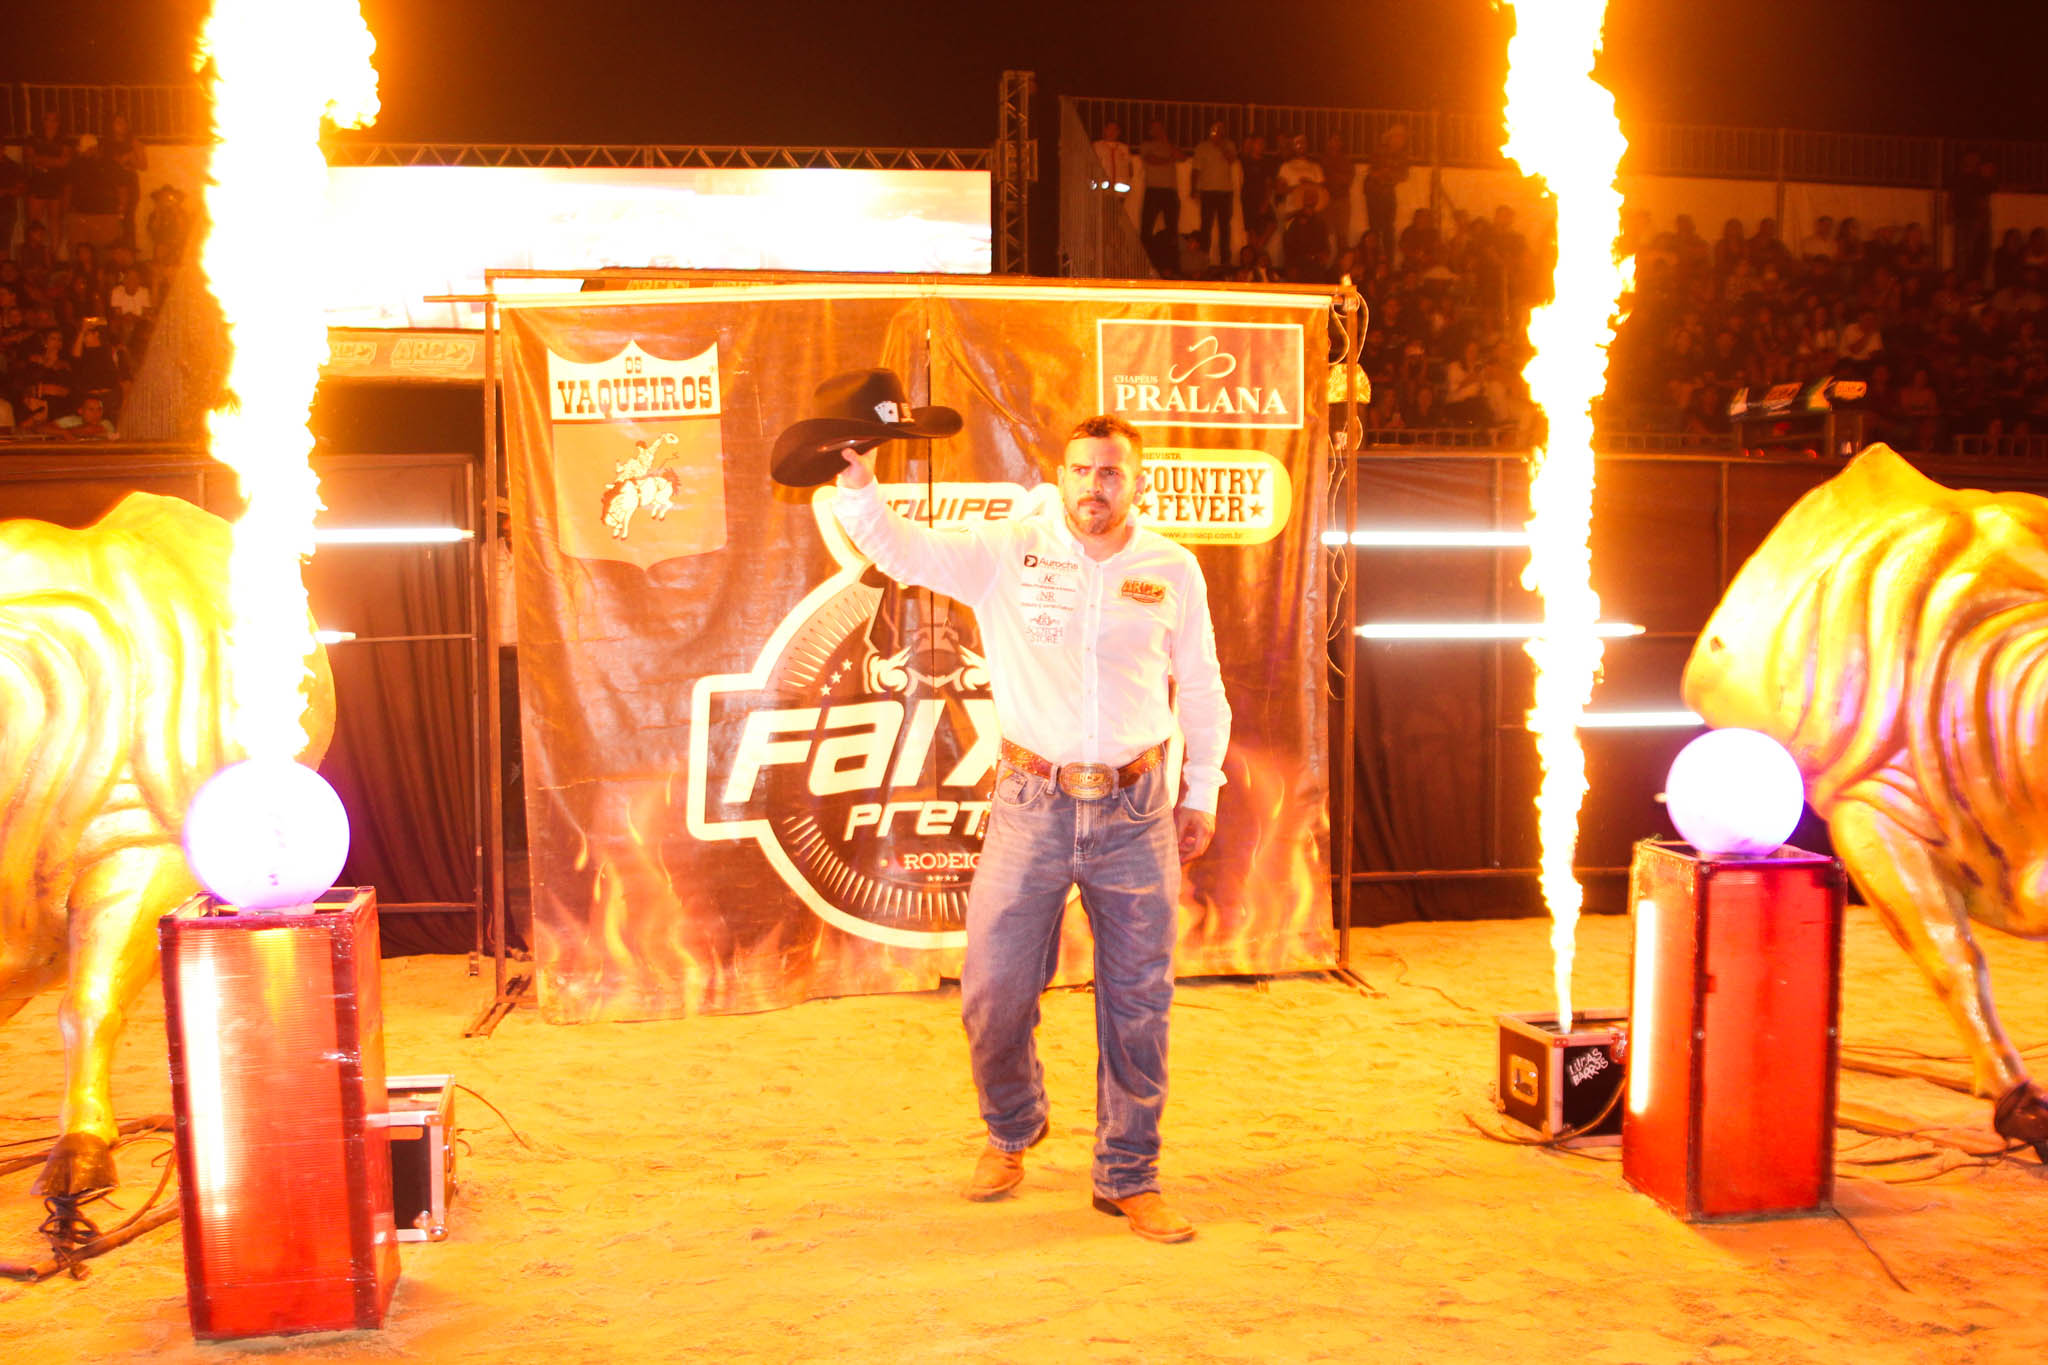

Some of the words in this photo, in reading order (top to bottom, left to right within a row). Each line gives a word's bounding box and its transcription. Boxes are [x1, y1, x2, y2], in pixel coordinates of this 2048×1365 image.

[625, 356, 642, 374] OS
[558, 376, 712, 418] VAQUEIROS
[1114, 384, 1288, 415] PRALANA
[1157, 494, 1246, 522] FEVER
